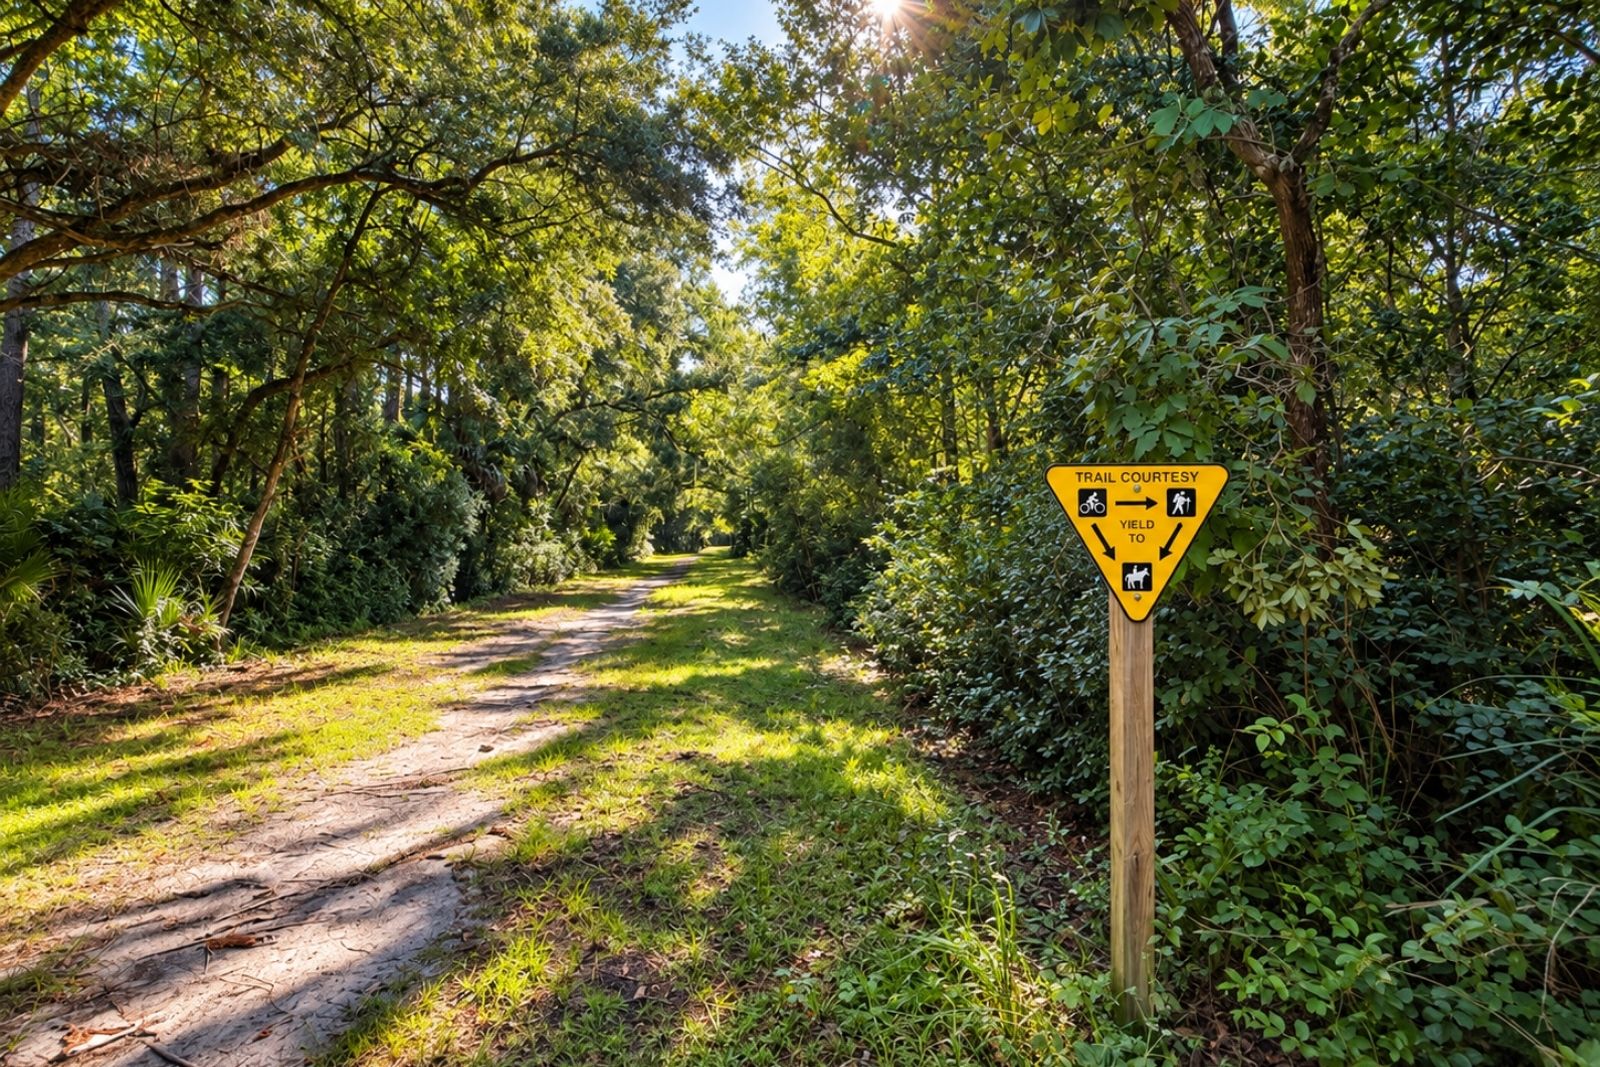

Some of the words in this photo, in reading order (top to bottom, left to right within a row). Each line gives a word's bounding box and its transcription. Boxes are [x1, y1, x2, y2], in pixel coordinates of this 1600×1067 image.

[1075, 471, 1116, 483] TRAIL
[1121, 471, 1199, 483] COURTESY
[1119, 519, 1155, 529] YIELD
[1128, 533, 1146, 544] TO
